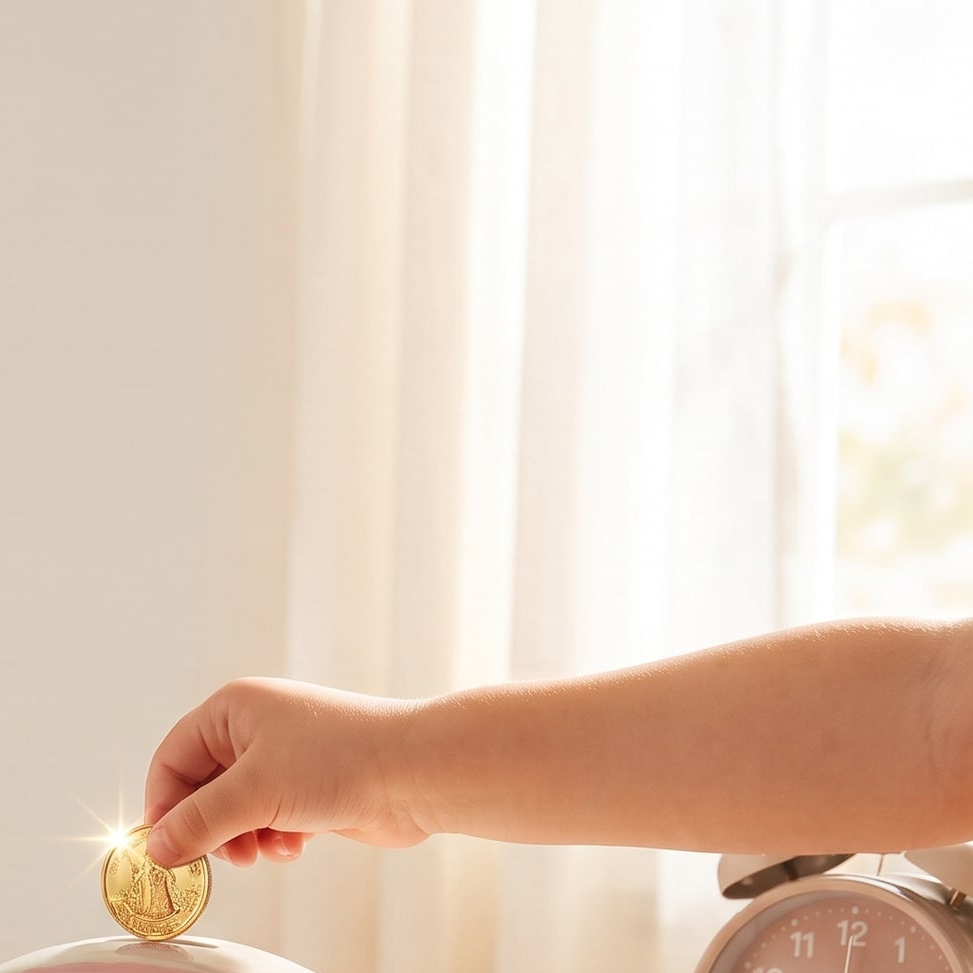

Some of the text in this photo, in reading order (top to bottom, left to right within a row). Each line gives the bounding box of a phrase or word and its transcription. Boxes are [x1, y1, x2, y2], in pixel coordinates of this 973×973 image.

[790, 932, 814, 958] 11
[837, 920, 867, 947] 12
[894, 937, 906, 963] 1
